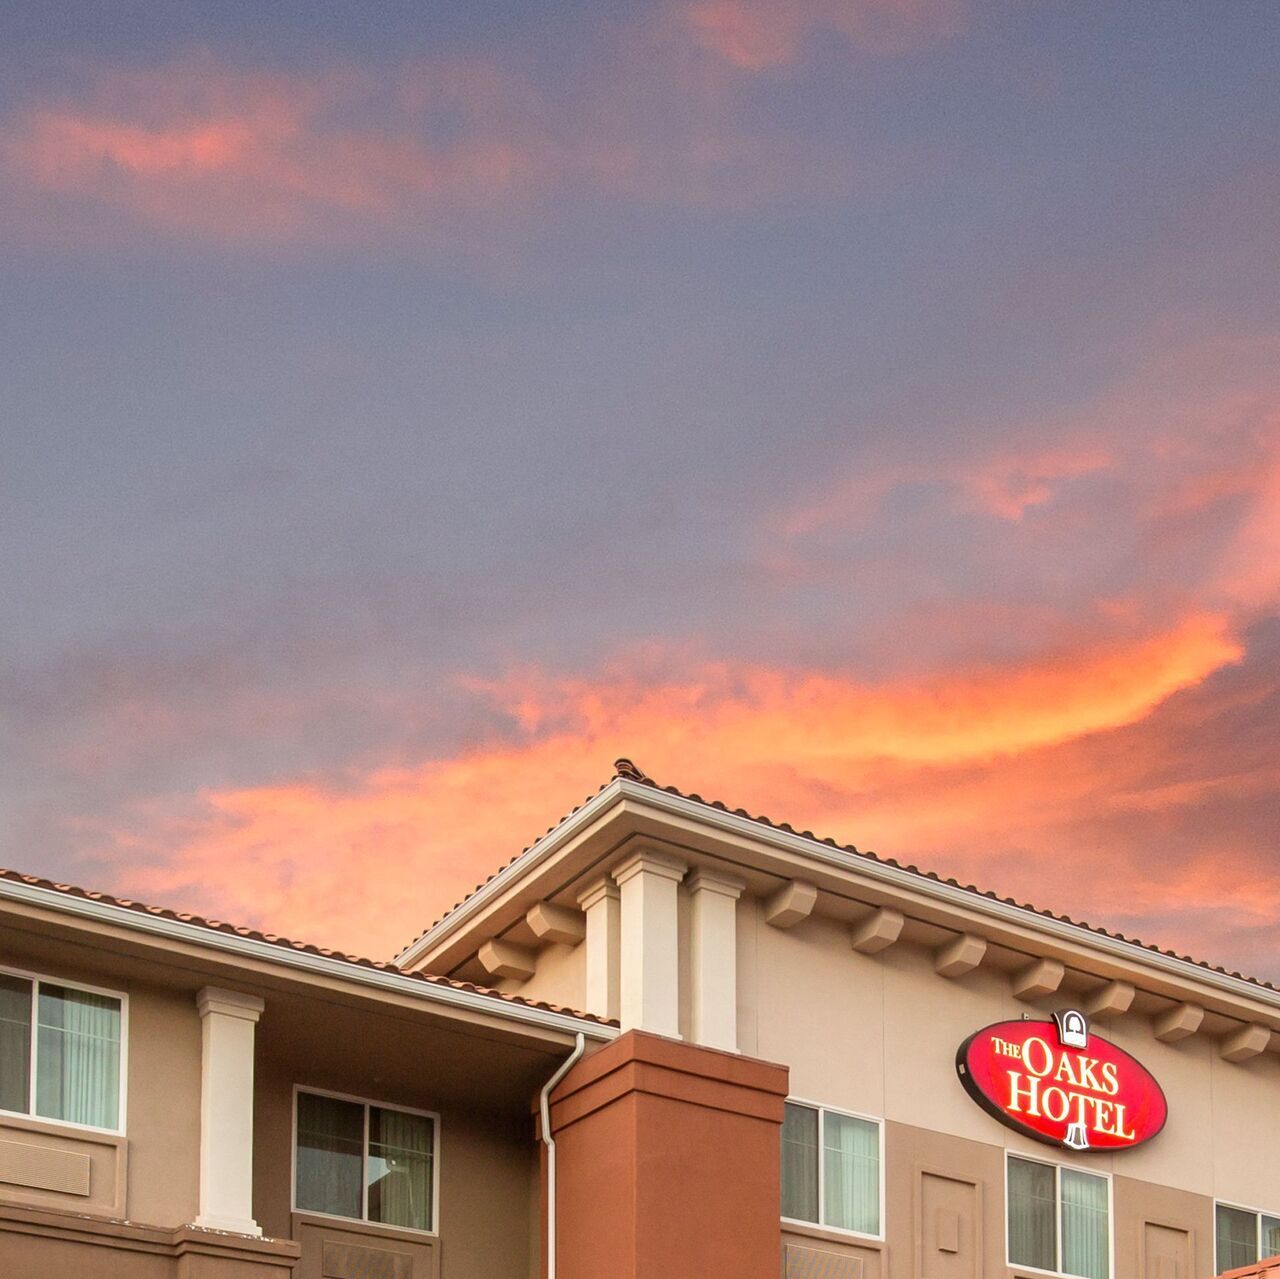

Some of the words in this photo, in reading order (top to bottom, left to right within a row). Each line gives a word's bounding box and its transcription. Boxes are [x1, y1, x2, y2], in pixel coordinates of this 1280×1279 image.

[991, 1037, 1021, 1060] THE
[1022, 1037, 1119, 1096] OAKS
[1006, 1070, 1135, 1140] HOTEL
